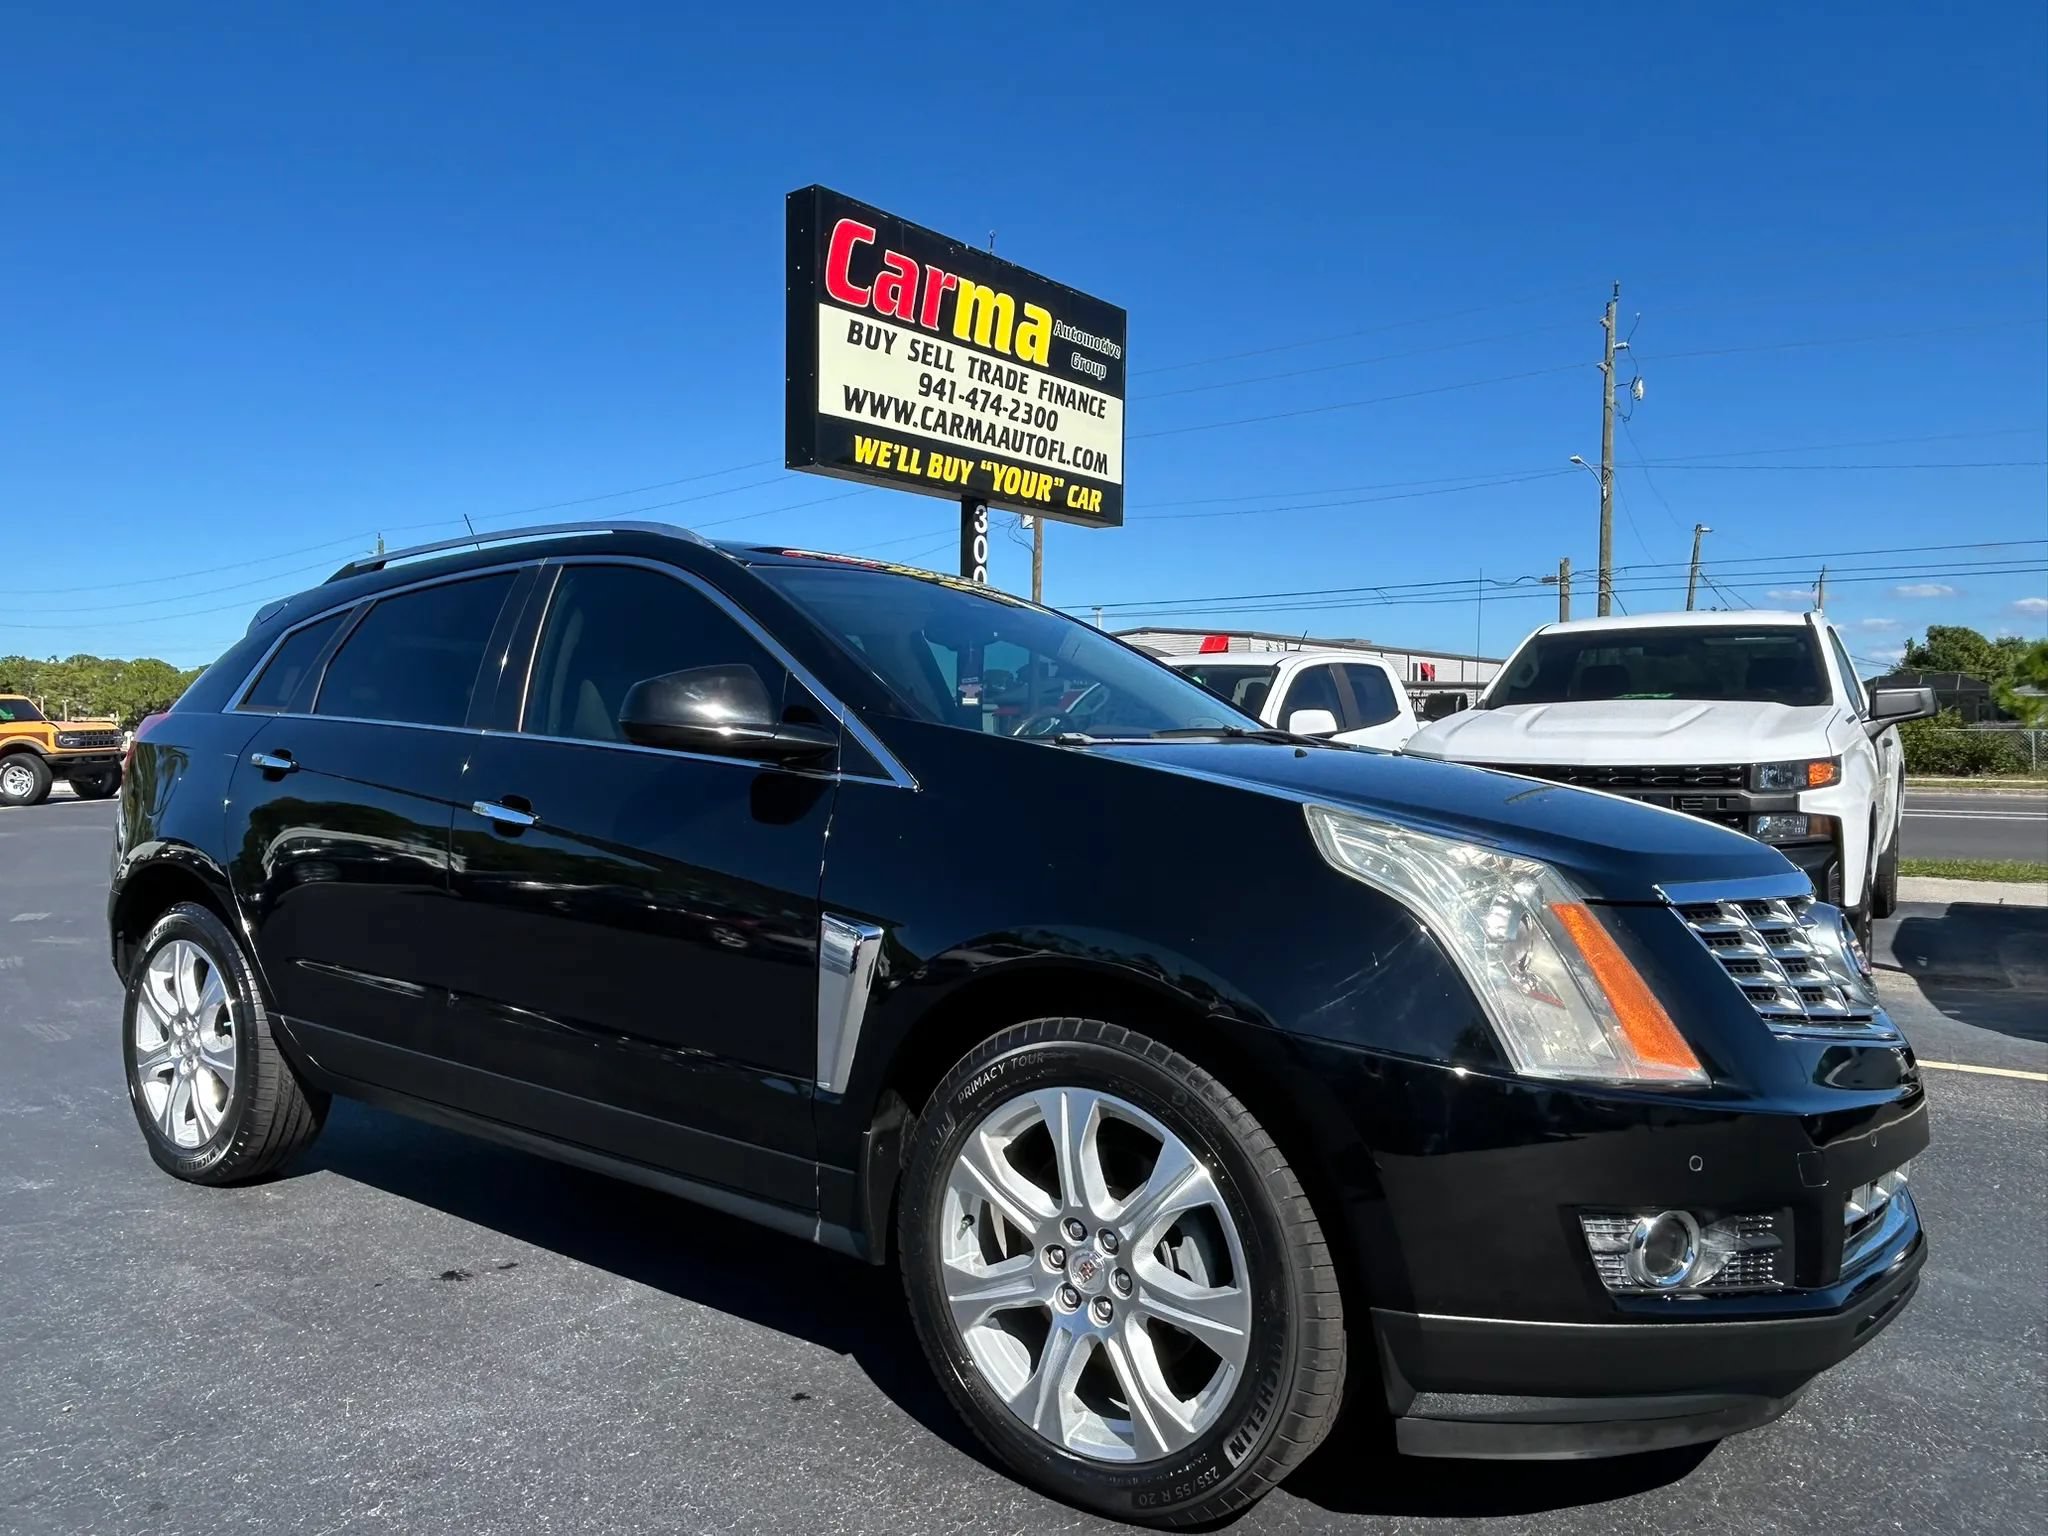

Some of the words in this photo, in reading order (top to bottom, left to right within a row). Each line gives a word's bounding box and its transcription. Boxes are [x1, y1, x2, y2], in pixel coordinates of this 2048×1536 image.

[825, 218, 1053, 367] Carma
[846, 318, 898, 355] BUY
[907, 338, 955, 373] SELL
[968, 356, 1029, 395] TRADE
[1038, 378, 1108, 420] FINANCE
[1053, 319, 1121, 359] Automotive
[1071, 352, 1107, 381] Group
[843, 384, 1108, 475] WWW.CARMAAUTOFL.COM
[918, 372, 1059, 432] 941-474-2300
[854, 435, 922, 476] WE'LL
[926, 455, 975, 486] BUY
[980, 458, 1064, 502] "YOUR"
[1066, 484, 1103, 513] CAR
[956, 1061, 1007, 1105] PRIMACY
[1010, 1051, 1045, 1071] TOUR
